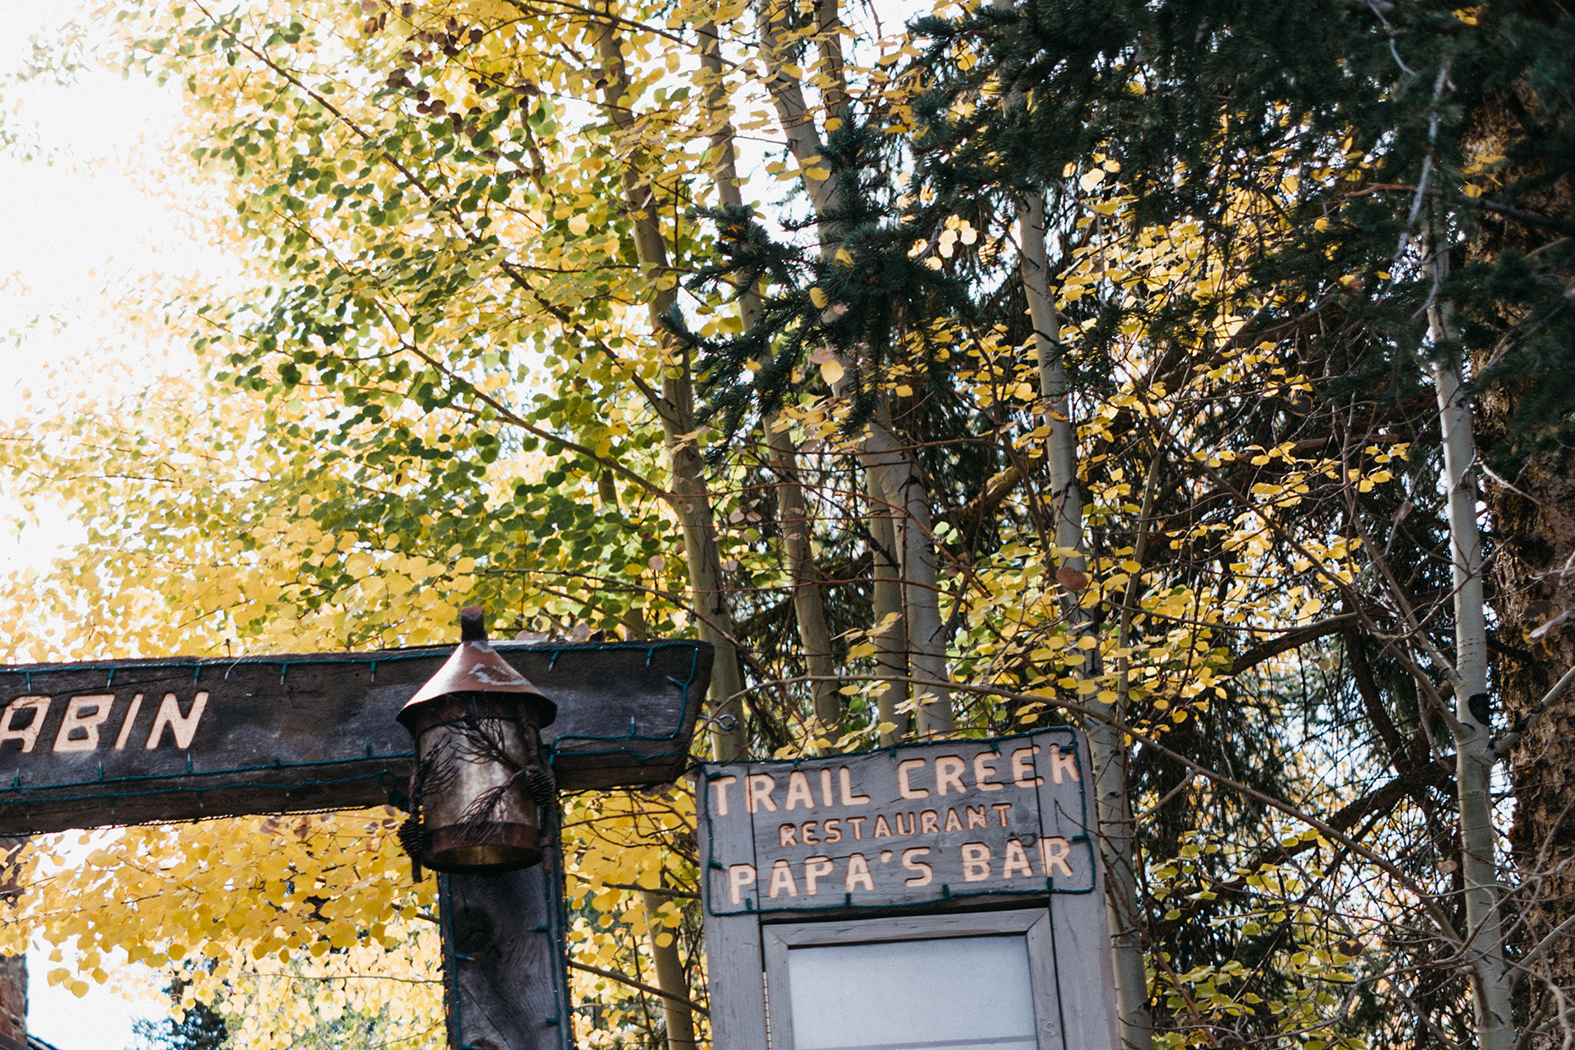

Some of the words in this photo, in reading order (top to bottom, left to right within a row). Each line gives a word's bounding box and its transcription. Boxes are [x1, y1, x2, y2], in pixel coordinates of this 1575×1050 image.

[708, 765, 871, 817] TRAIL
[897, 742, 1081, 800] CREEK
[778, 802, 1014, 849] RESTAURANT
[728, 846, 934, 905] PAPA'S
[961, 835, 1075, 883] BAR
